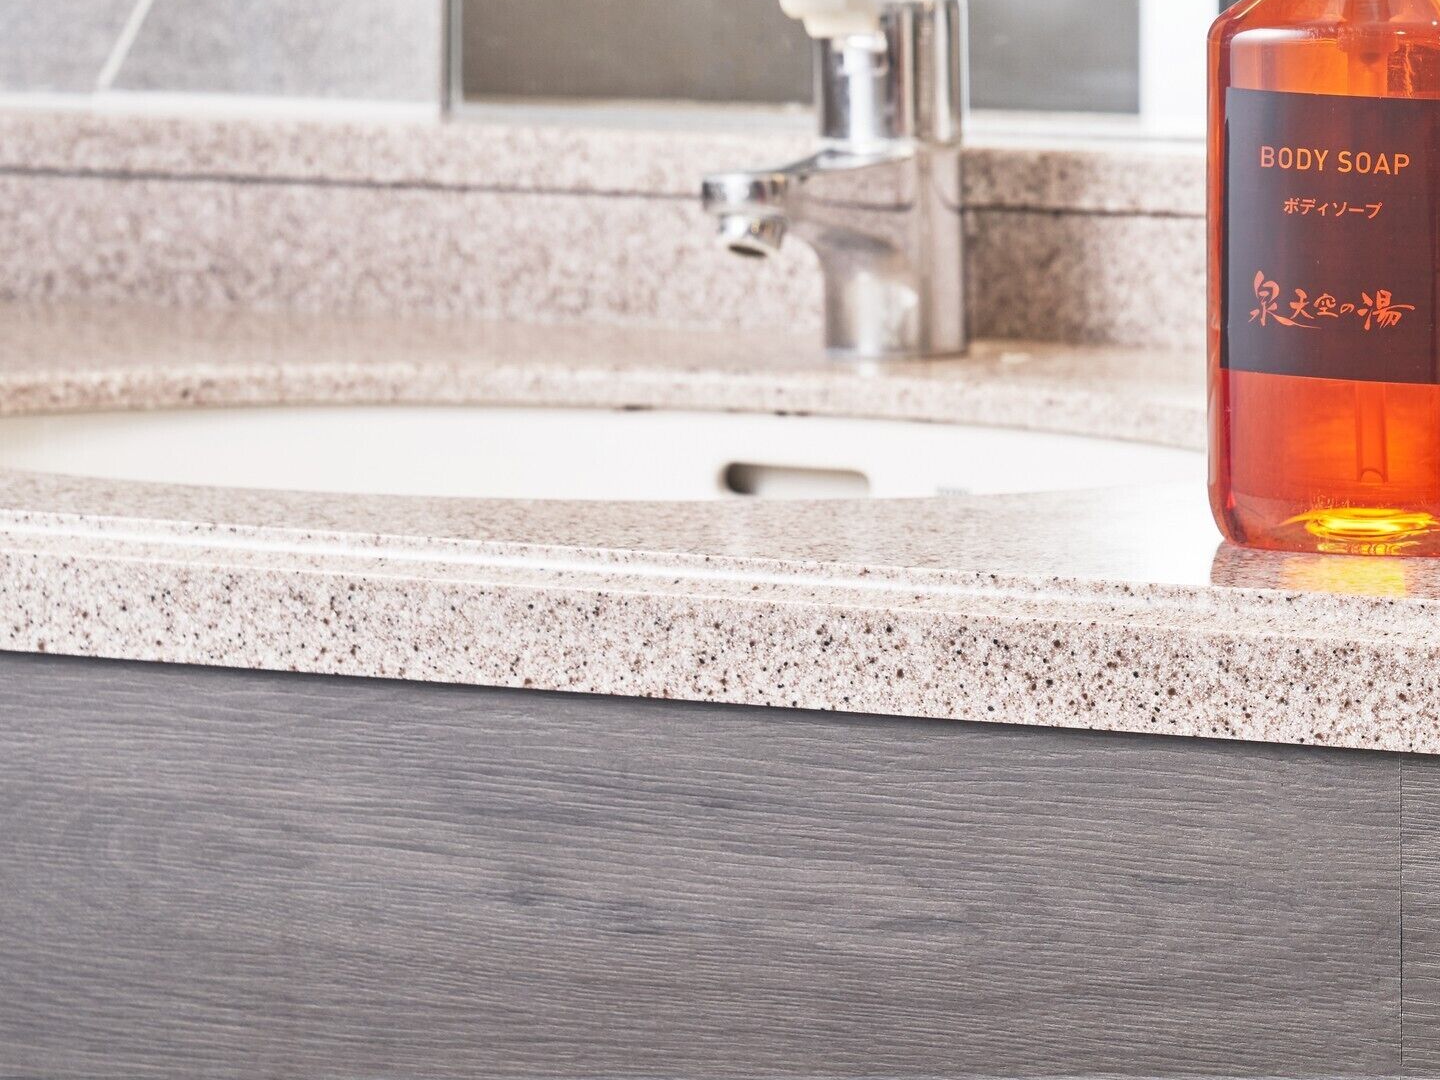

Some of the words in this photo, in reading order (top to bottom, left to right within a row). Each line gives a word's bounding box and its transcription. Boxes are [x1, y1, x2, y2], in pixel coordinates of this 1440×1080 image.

[1260, 145, 1329, 171] BODY
[1336, 150, 1411, 176] SOAP
[1283, 197, 1384, 220] ボディソープ
